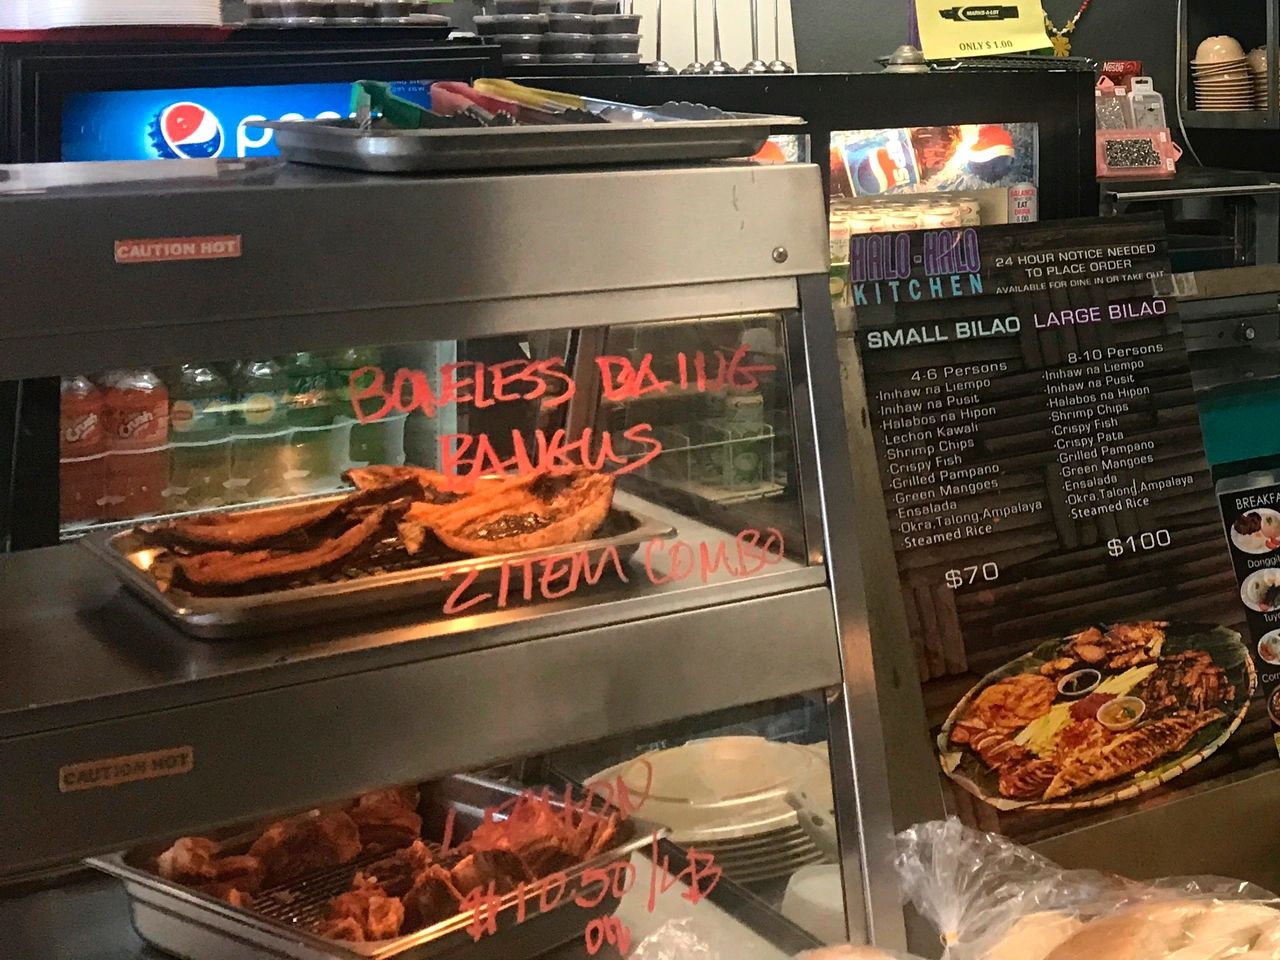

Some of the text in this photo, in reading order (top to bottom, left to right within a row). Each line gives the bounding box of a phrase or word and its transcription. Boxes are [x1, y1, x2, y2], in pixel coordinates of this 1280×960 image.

[959, 40, 1013, 51] ONLY $ 1.00
[117, 240, 236, 258] CAUTION HOT
[850, 228, 981, 282] HALO-HALO
[995, 244, 1155, 268] 24 HOUR NOTICE NEEDED
[1025, 259, 1132, 278] TO PLACE ORDER
[854, 273, 983, 305] KITCHEN
[996, 283, 1047, 294] AVAILABLE
[1070, 278, 1092, 287] DINE
[1122, 273, 1144, 281] TAKE
[1034, 300, 1167, 328] LARGE BILAO
[867, 316, 1020, 349] SMALL BILAO
[1068, 343, 1163, 364] 8-10 Persons
[911, 362, 1008, 381] 4-6 Persons
[1045, 360, 1144, 380] Inihaw na Liempo
[349, 355, 576, 424] BONELESS
[879, 378, 990, 401] Inihaw na Liempo
[1047, 374, 1135, 394] Inihaw na Pusit
[881, 394, 980, 416] Inihaw na Pusit
[1050, 386, 1150, 408] Halabos na Hipon
[883, 406, 997, 430] Halabos na Hipon
[1051, 403, 1129, 422] Shrimp Chips
[66, 413, 98, 442] Crush
[119, 411, 153, 438] Crush
[885, 423, 979, 445] Lechon Kawali
[1054, 418, 1118, 436] Crispy Fish
[887, 439, 974, 460] Shrimp Chips
[1056, 431, 1124, 449] Crispy Pata
[437, 423, 663, 492] BANGUS
[1059, 440, 1154, 463] Grilled Pampano
[889, 455, 962, 475] Crispy Fish
[1062, 455, 1154, 477] Green Mangoes
[892, 464, 1000, 489] Grilled Pampano
[1065, 474, 1118, 491] Ensalada
[896, 479, 999, 504] Green Mangoes
[898, 501, 957, 519] Ensalada
[1071, 497, 1149, 519] Steamed Rice
[904, 524, 993, 549] Steamed Rice
[1107, 529, 1171, 556] $100
[442, 527, 784, 614] 2 ITEM COMBO
[945, 562, 999, 589] $70
[64, 753, 188, 784] CAUTION HOT
